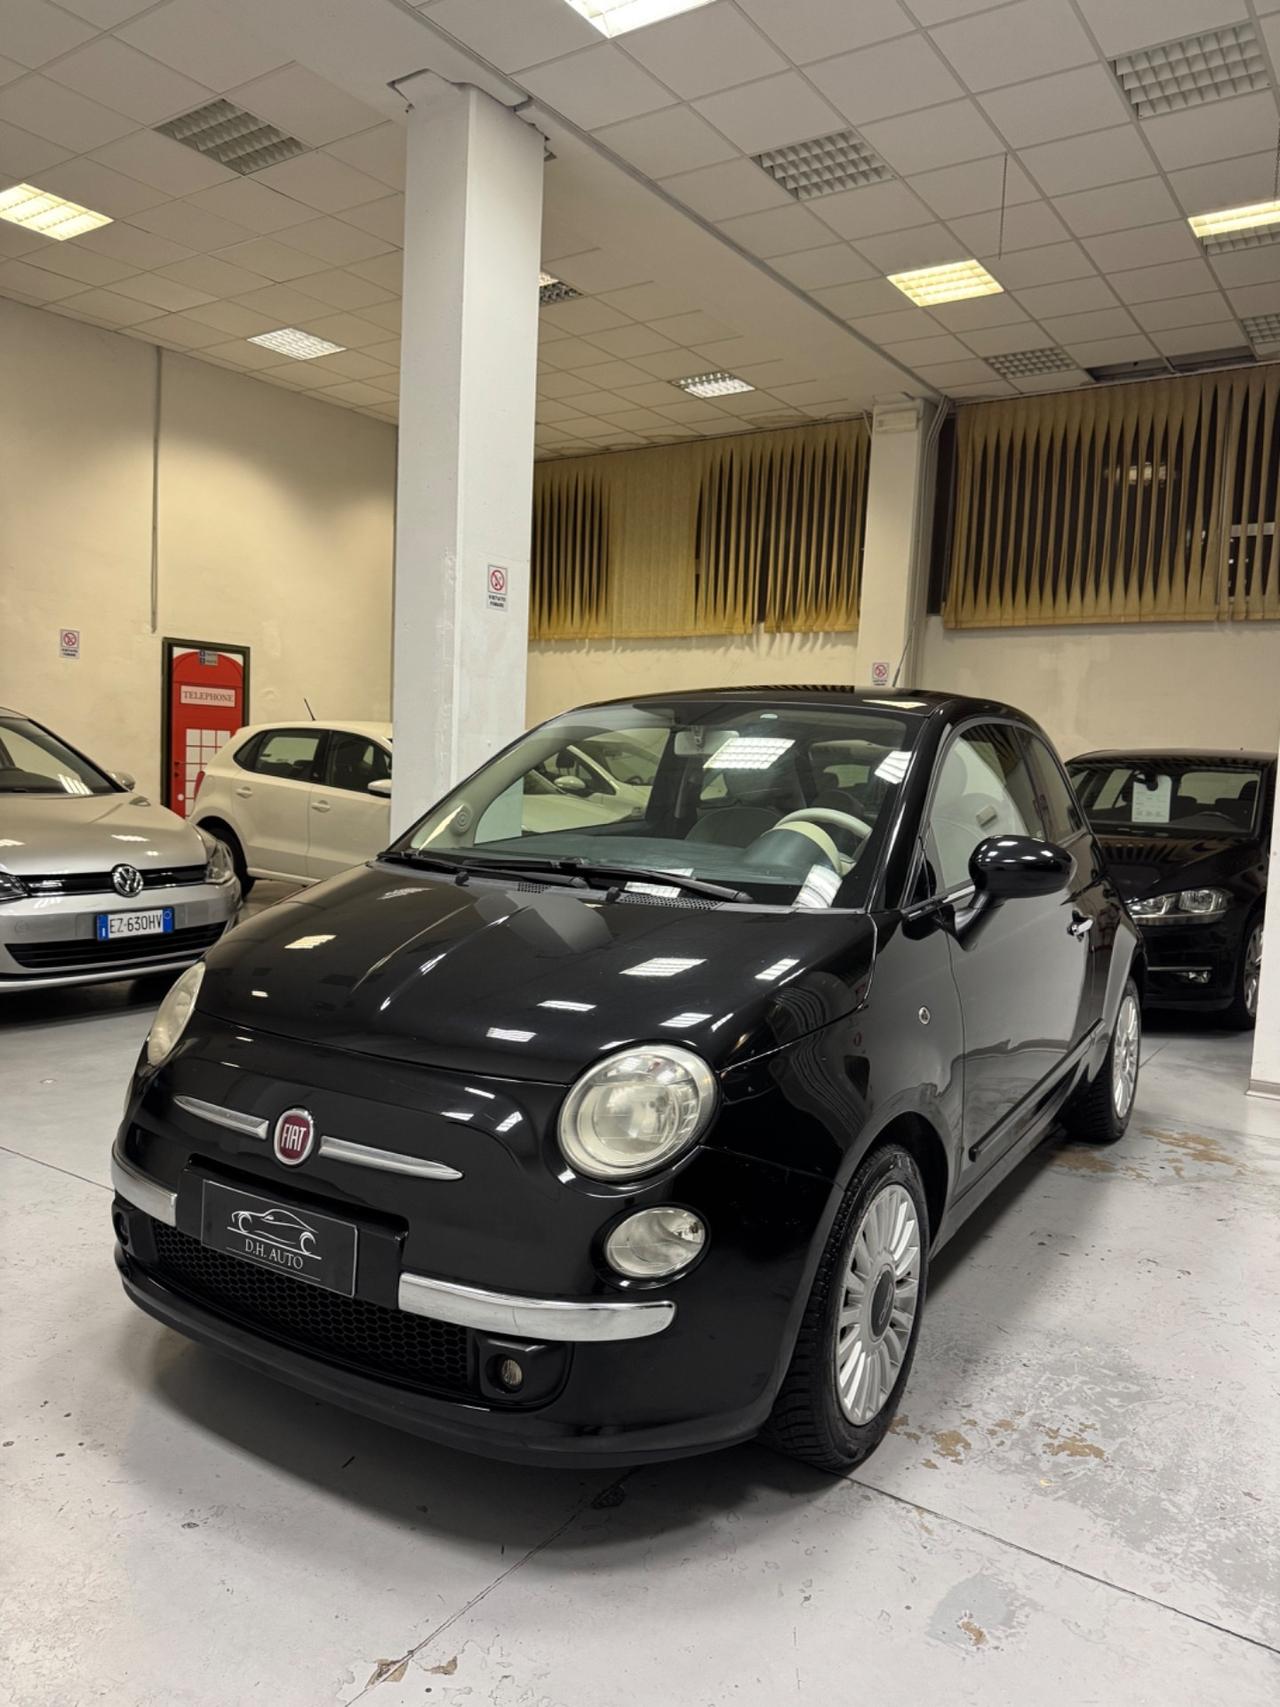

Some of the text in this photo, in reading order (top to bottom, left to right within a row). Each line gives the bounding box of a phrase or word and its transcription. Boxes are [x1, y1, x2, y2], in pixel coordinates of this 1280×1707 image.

[183, 690, 234, 702] TELEPHONE
[281, 1123, 307, 1151] FIAT
[245, 1239, 303, 1270] D.H. AUTO
